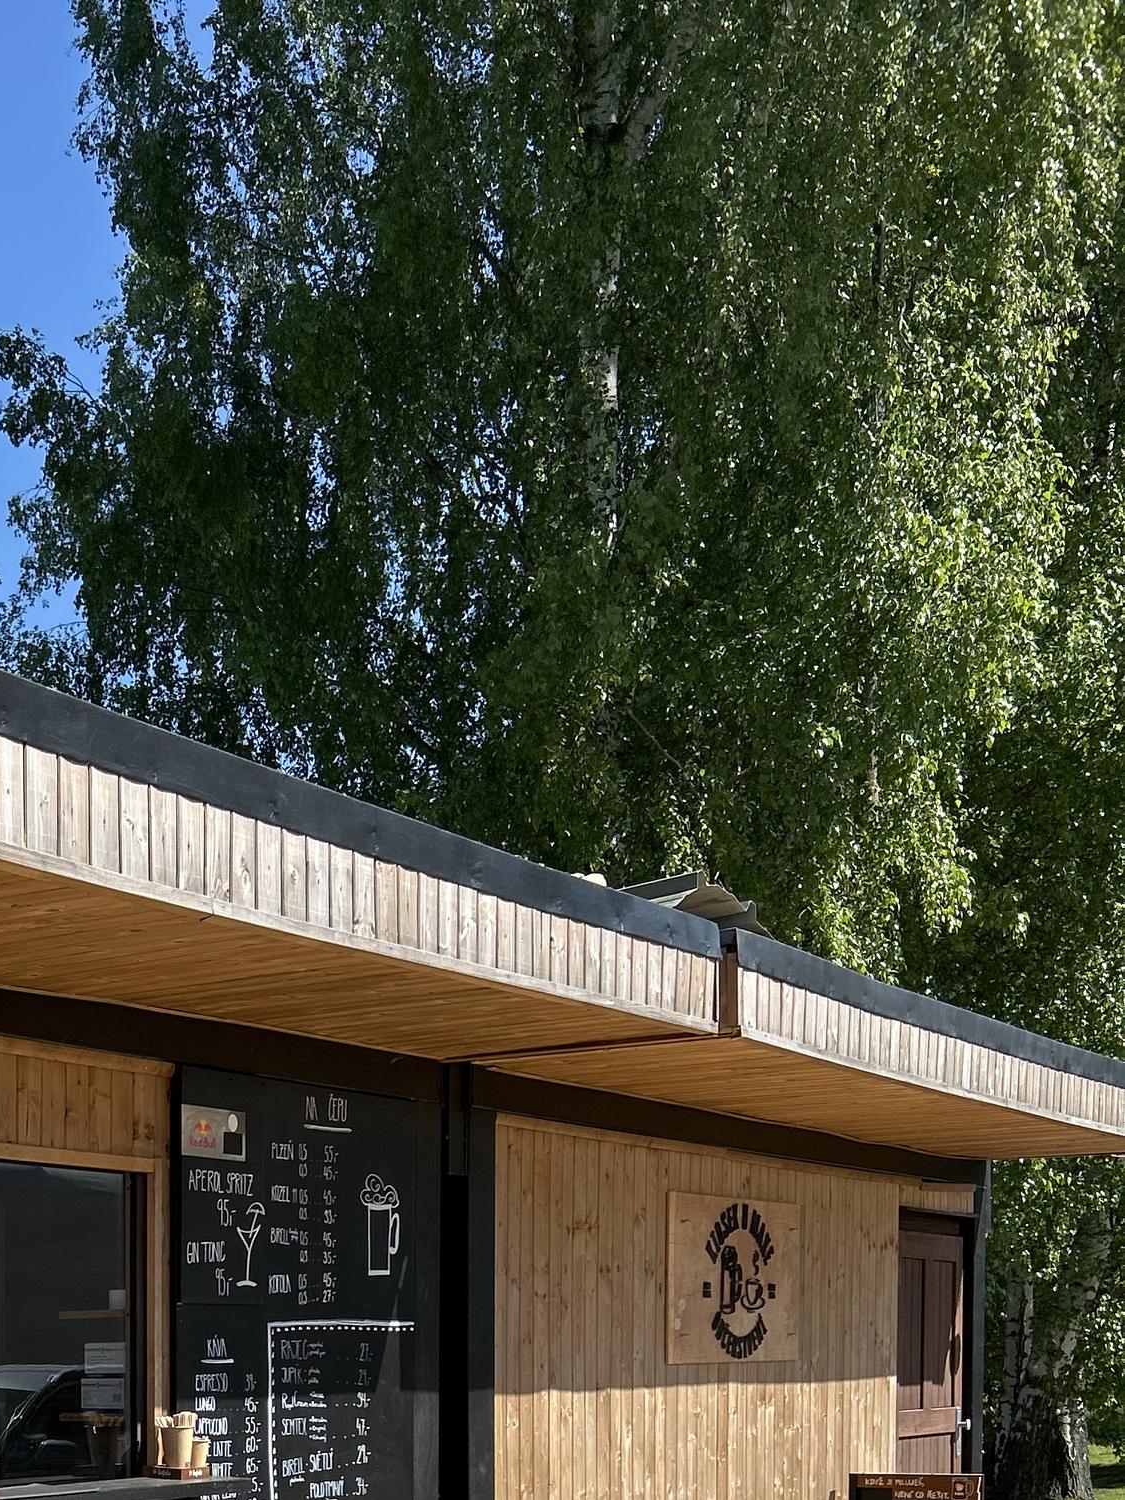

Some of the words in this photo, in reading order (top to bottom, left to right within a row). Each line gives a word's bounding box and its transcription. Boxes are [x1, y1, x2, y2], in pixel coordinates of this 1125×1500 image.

[305, 1096, 318, 1121] NA
[328, 1093, 348, 1122] ČEPU
[271, 1140, 294, 1160] PLZEŇ
[188, 1169, 224, 1193] APEROL
[226, 1172, 253, 1196] SPRITZ
[186, 1241, 199, 1264] GIN
[200, 1241, 226, 1262] TONIC
[207, 1334, 227, 1357] KÁVA
[281, 1339, 308, 1360] RAJEC
[195, 1372, 228, 1392] ESPRESSO
[281, 1417, 307, 1436] SEMTEX
[915, 1491, 924, 1499] CO
